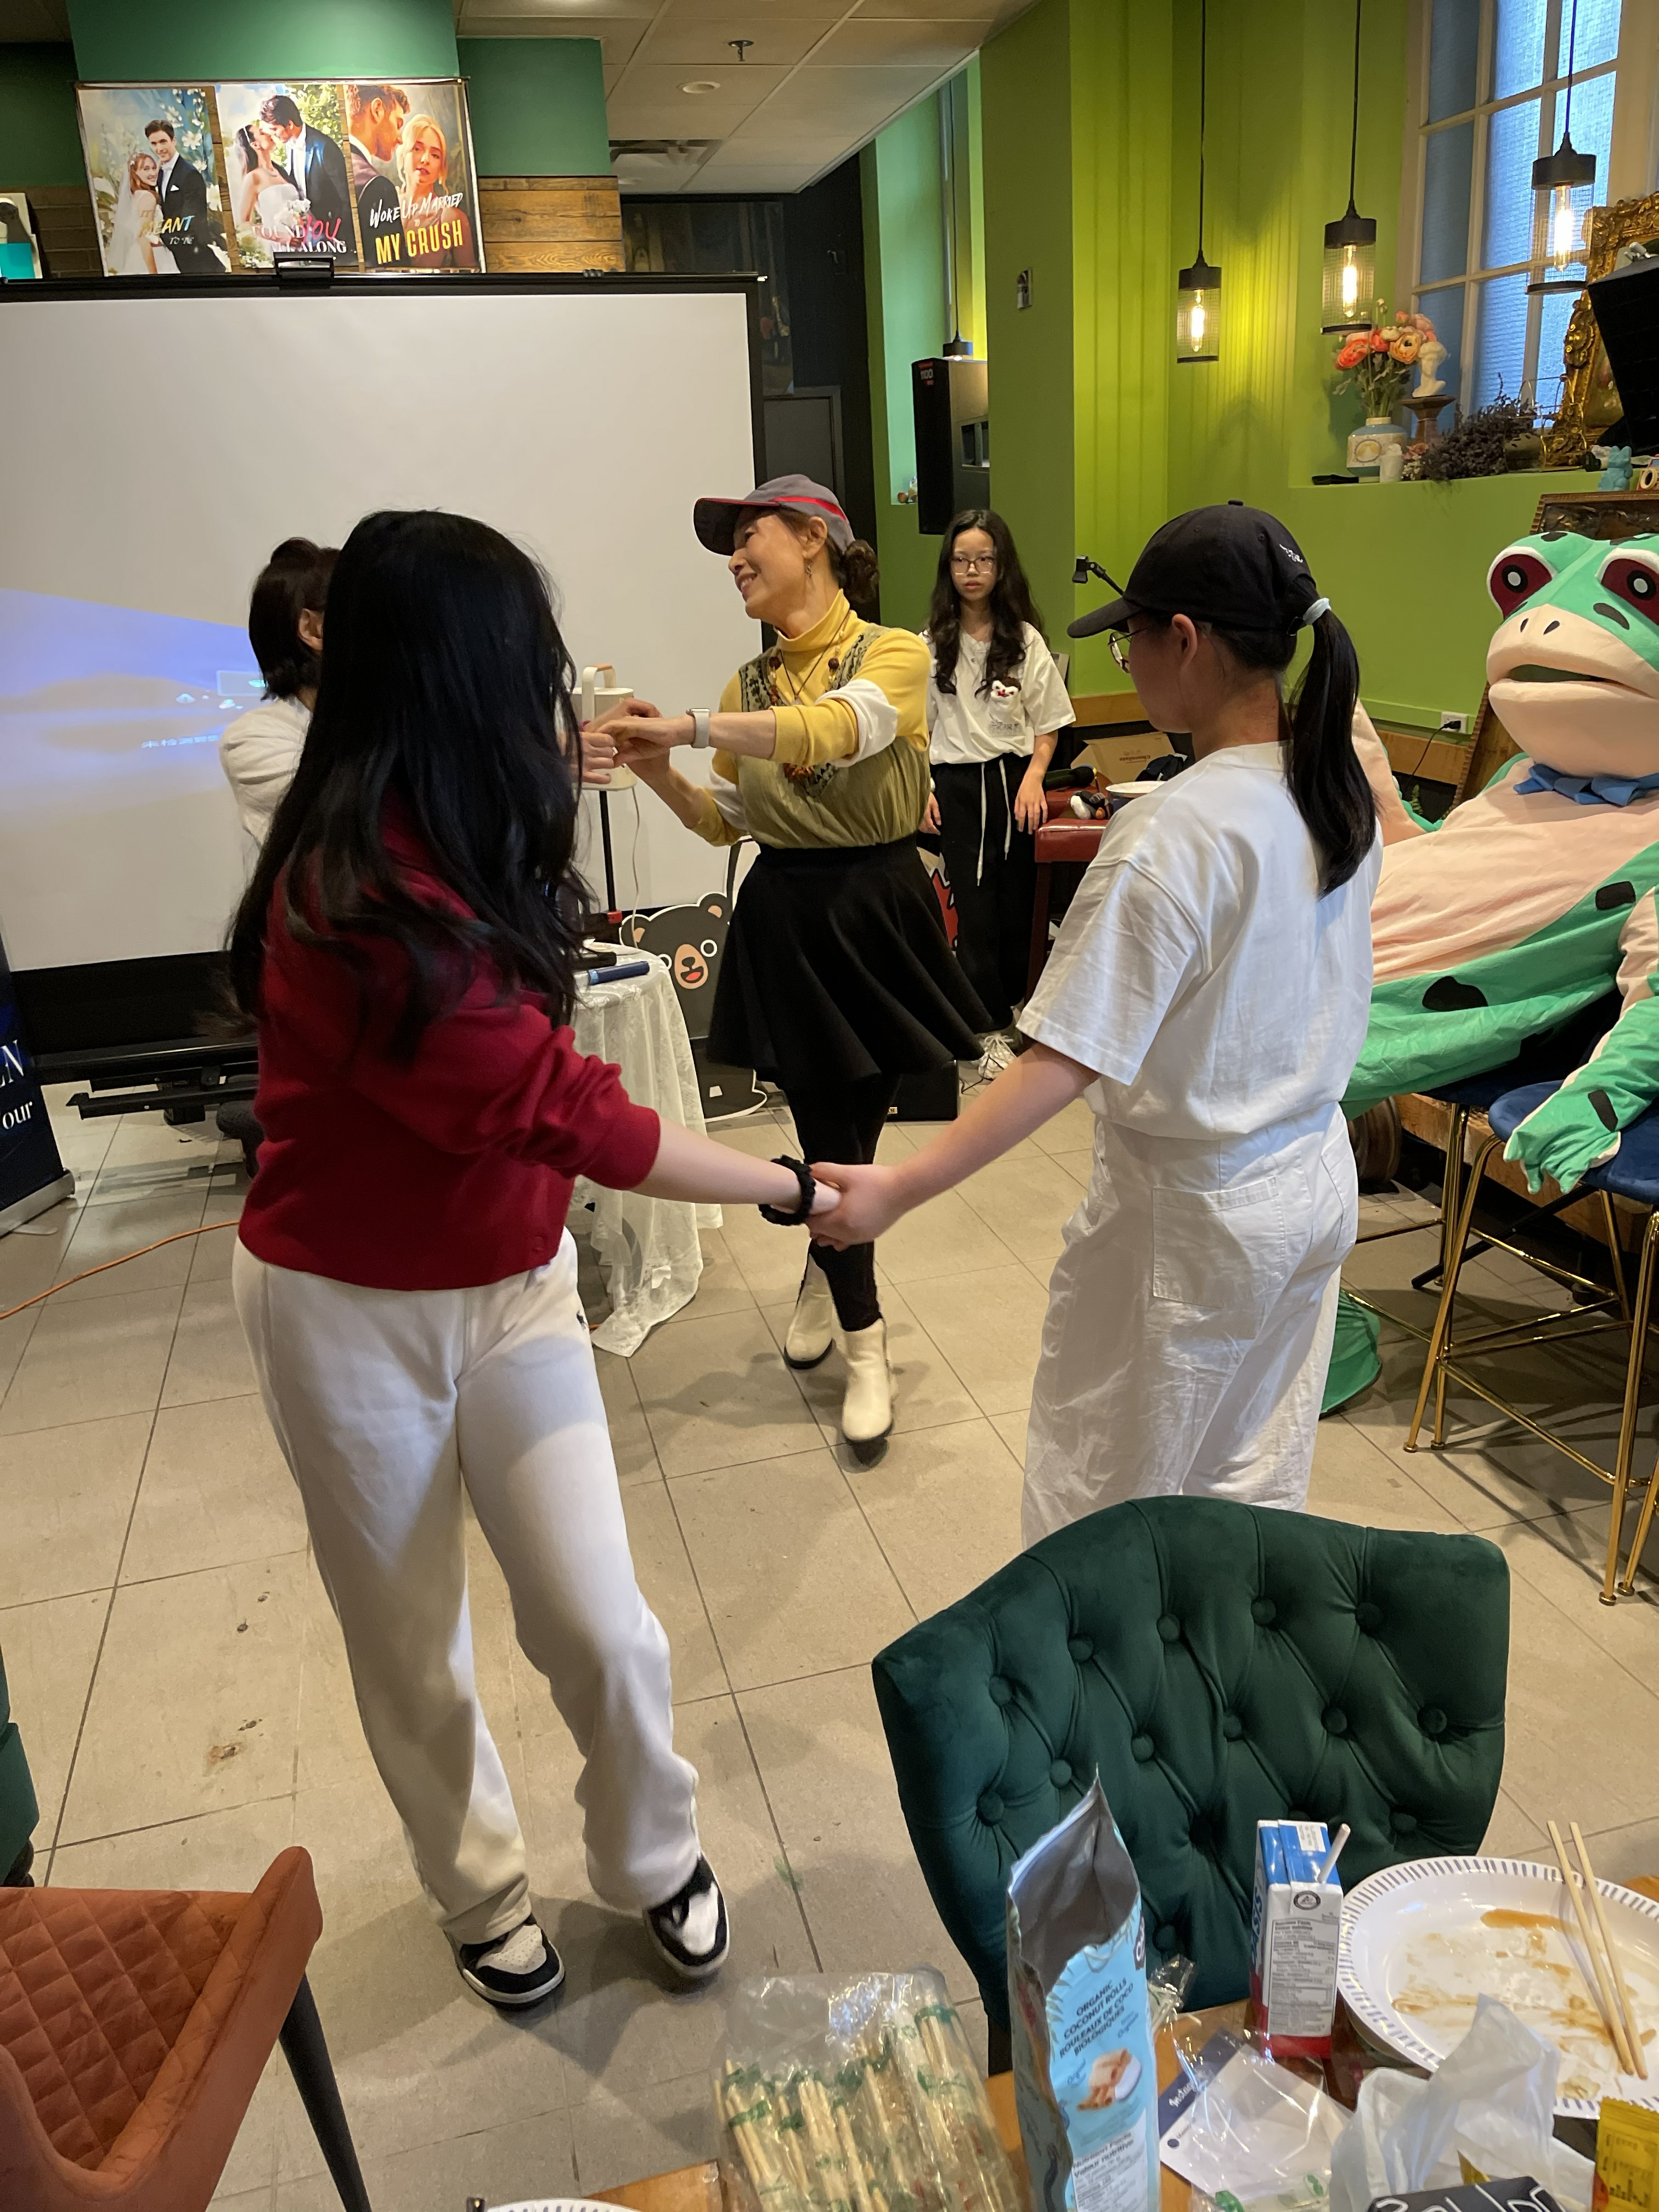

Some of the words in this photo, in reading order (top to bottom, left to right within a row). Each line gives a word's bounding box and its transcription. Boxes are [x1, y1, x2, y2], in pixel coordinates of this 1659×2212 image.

[298, 215, 341, 244] YOU
[299, 240, 347, 253] ALONG
[375, 233, 400, 264] MY
[406, 219, 463, 257] CRUSH
[1059, 2018, 1103, 2058] ROULEAUX
[1103, 2005, 1114, 2020] DE
[1114, 1983, 1134, 2008] COCO
[1064, 2001, 1104, 2040] COCONUT
[1105, 1977, 1127, 2005] ROLLS
[1076, 1979, 1113, 2017] ORGANIC
[1074, 2005, 1125, 2057] BIOLOGIQUES
